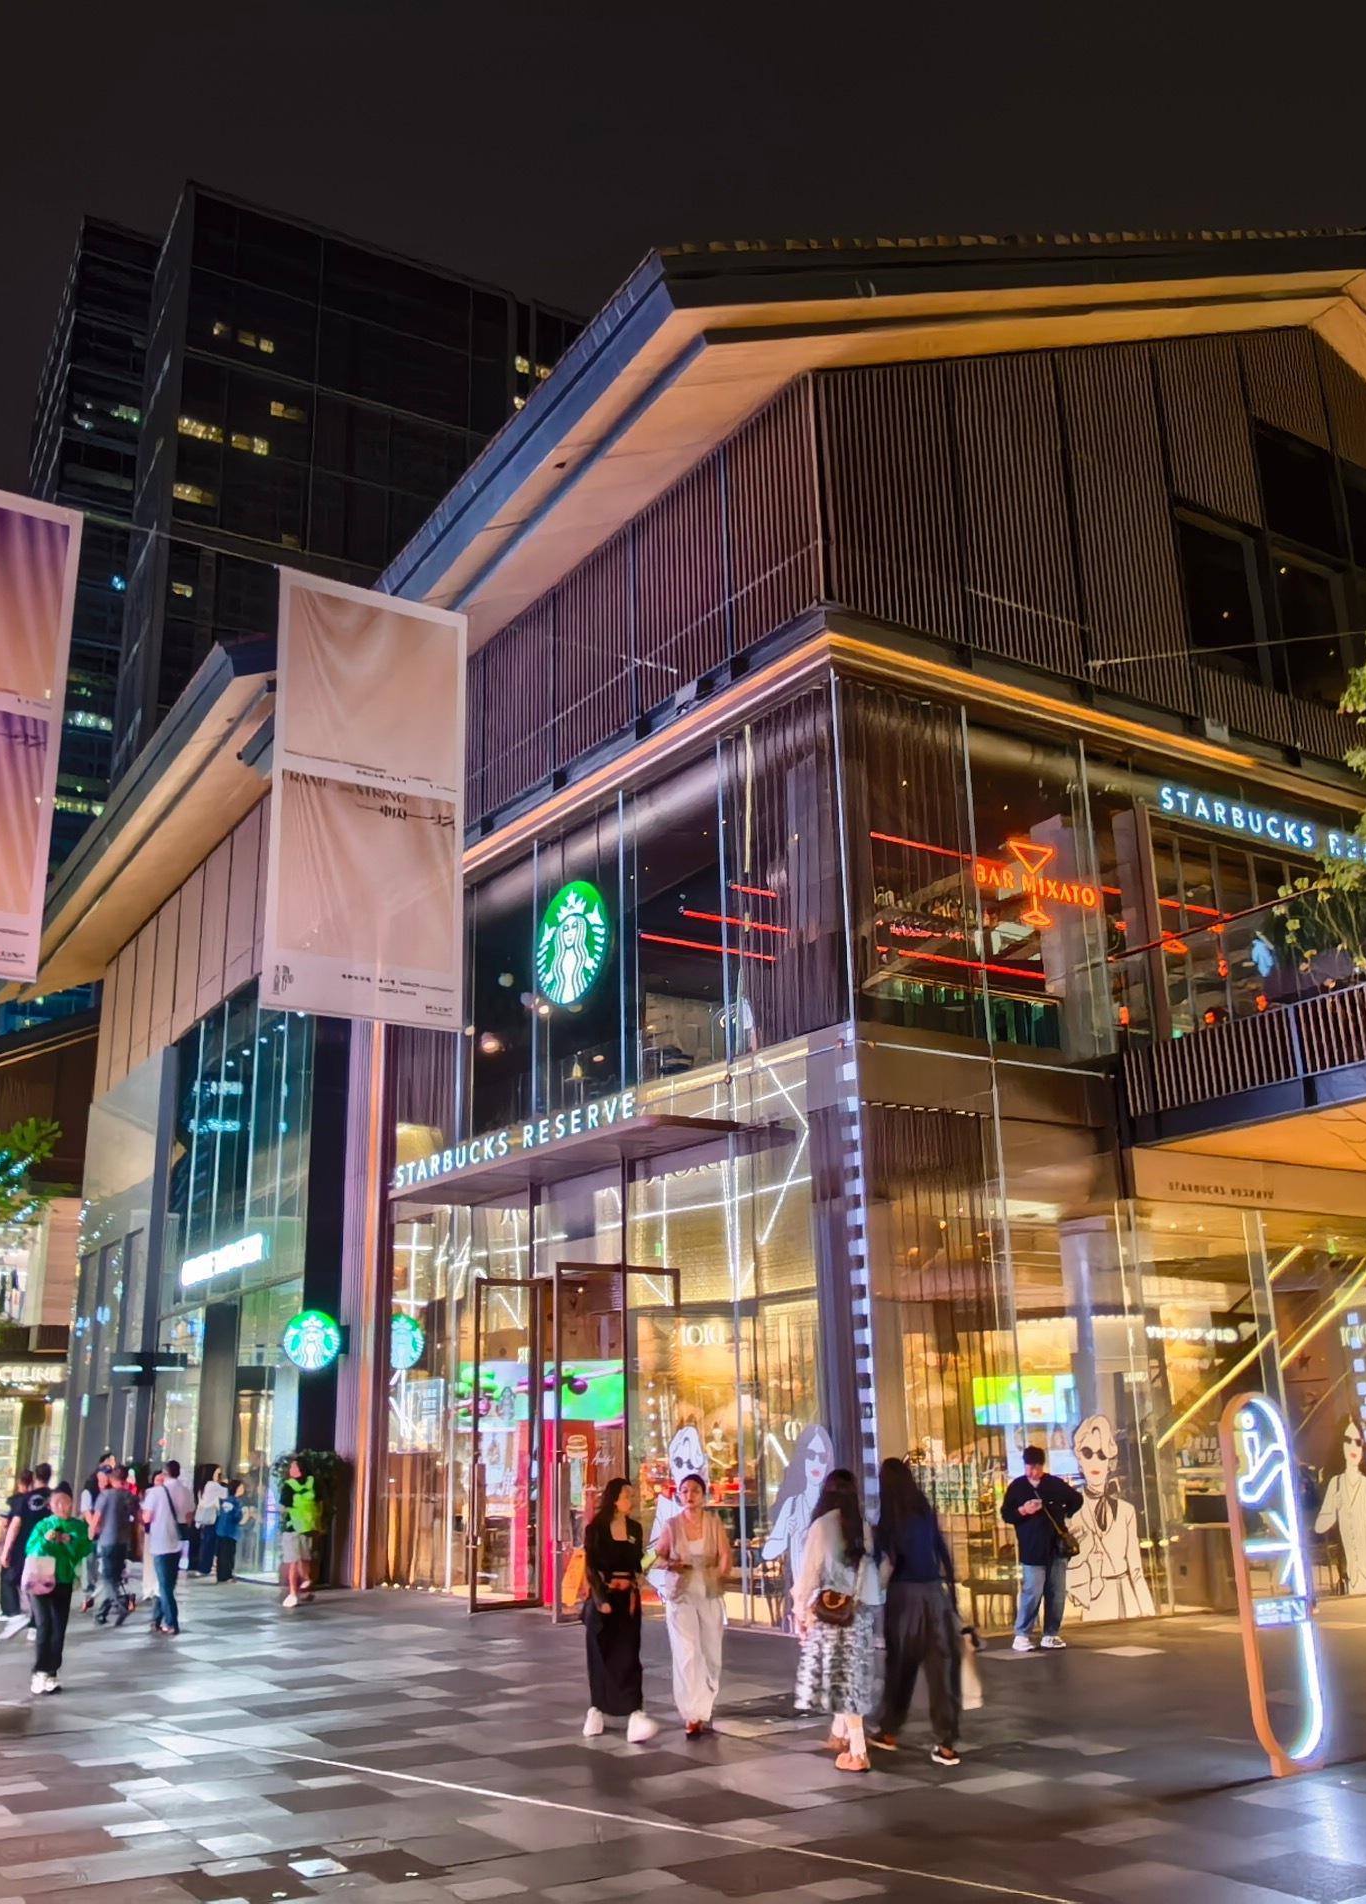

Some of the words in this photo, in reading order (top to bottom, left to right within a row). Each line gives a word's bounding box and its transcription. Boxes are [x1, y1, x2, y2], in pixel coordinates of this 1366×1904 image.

[1160, 787, 1314, 848] STARBUCKS
[975, 863, 1014, 889] BAR
[1021, 873, 1095, 907] MIXATO
[394, 1131, 508, 1189] STARBUCKS
[522, 1092, 636, 1149] RESERVE
